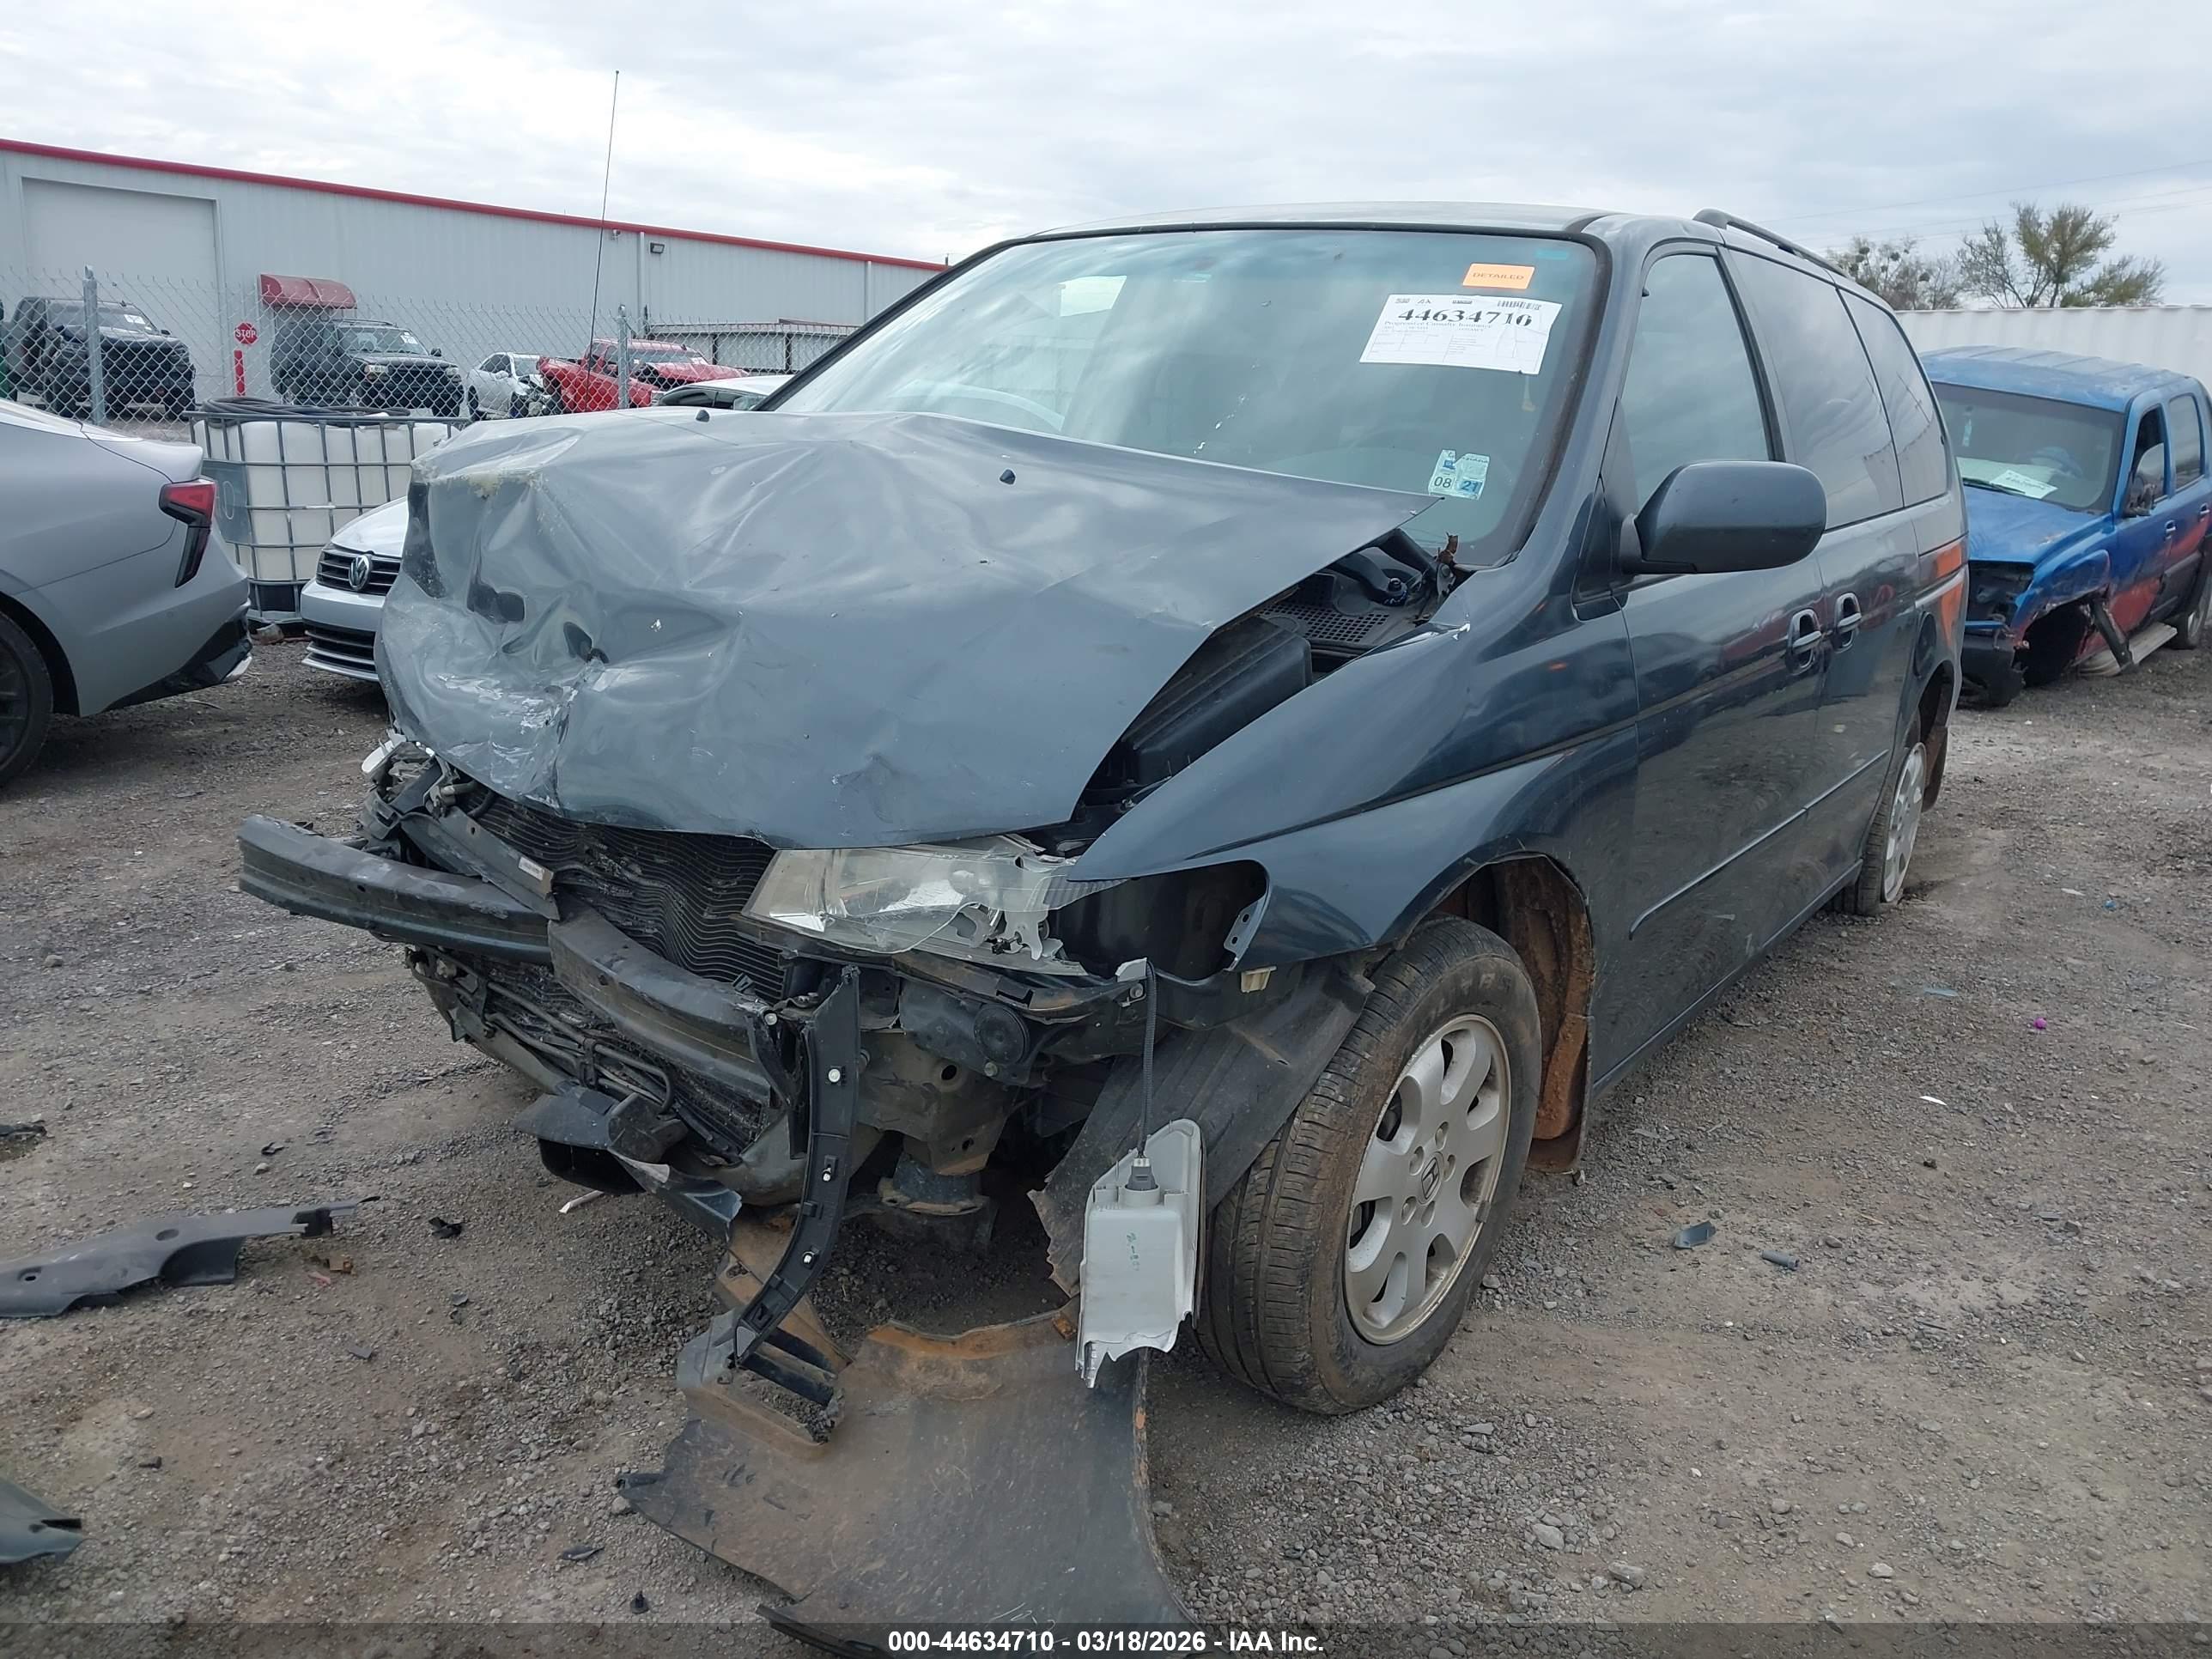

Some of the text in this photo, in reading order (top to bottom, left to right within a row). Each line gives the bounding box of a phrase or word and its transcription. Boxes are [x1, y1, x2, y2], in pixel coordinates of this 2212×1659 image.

[1473, 271, 1524, 281] DETAILED
[1398, 308, 1532, 327] 44634710
[234, 328, 257, 338] STOP
[1434, 476, 1479, 492] 08 21
